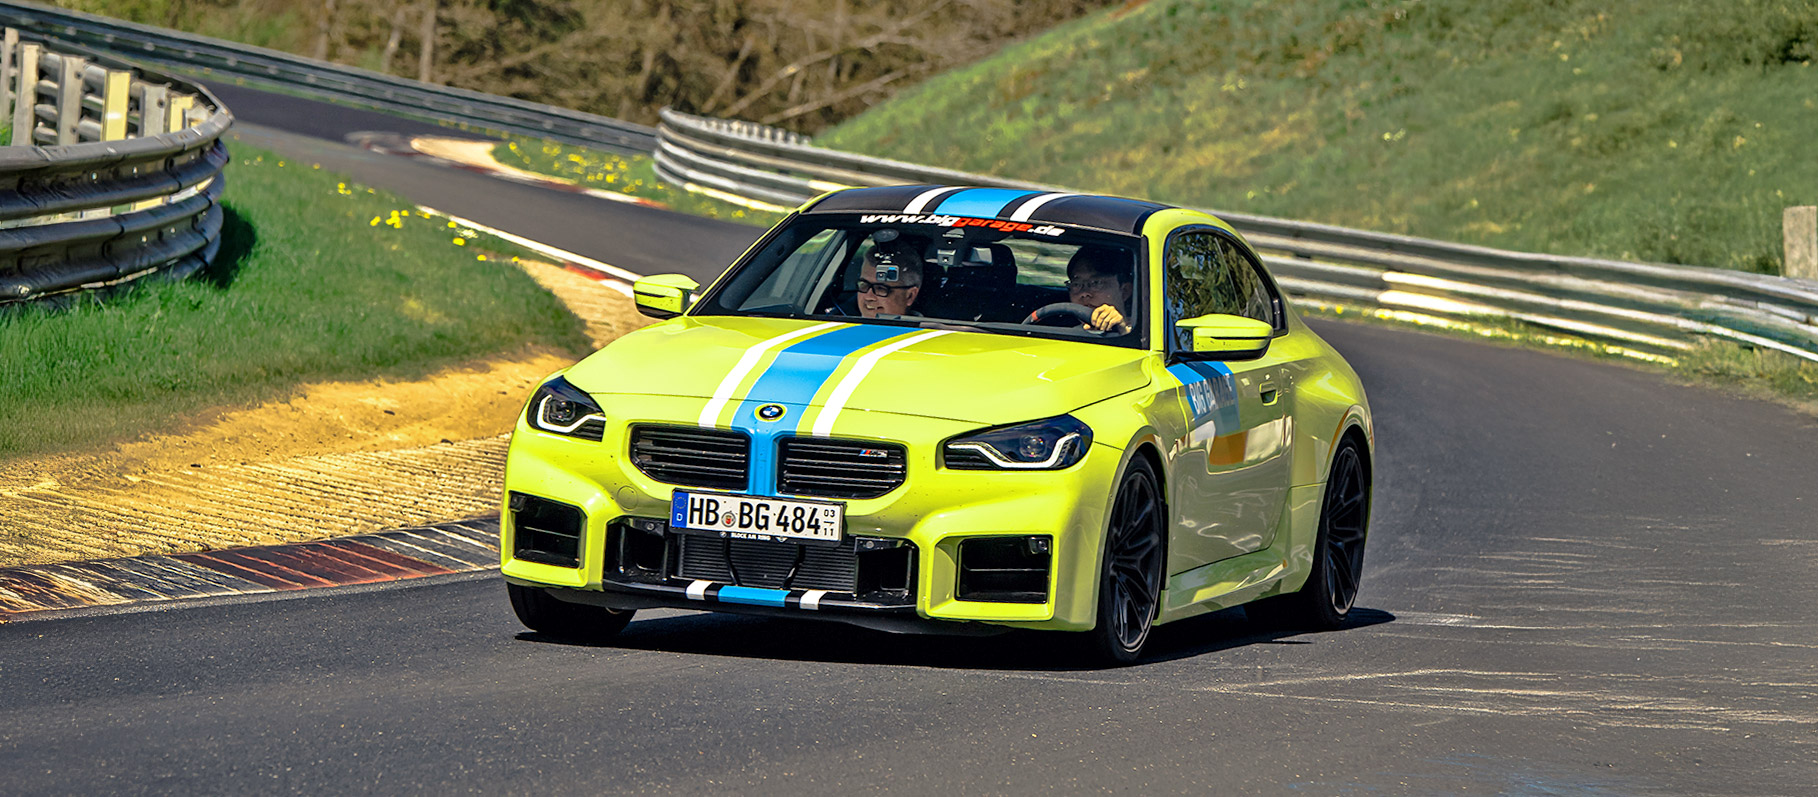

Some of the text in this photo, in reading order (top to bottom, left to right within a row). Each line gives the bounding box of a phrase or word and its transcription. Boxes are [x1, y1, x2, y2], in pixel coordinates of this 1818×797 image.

[860, 214, 1065, 237] www.biggarage.de
[1188, 381, 1207, 415] BIG
[675, 513, 683, 522] D
[688, 497, 821, 536] HB BG 484
[823, 509, 836, 518] 03
[822, 527, 835, 537] 11
